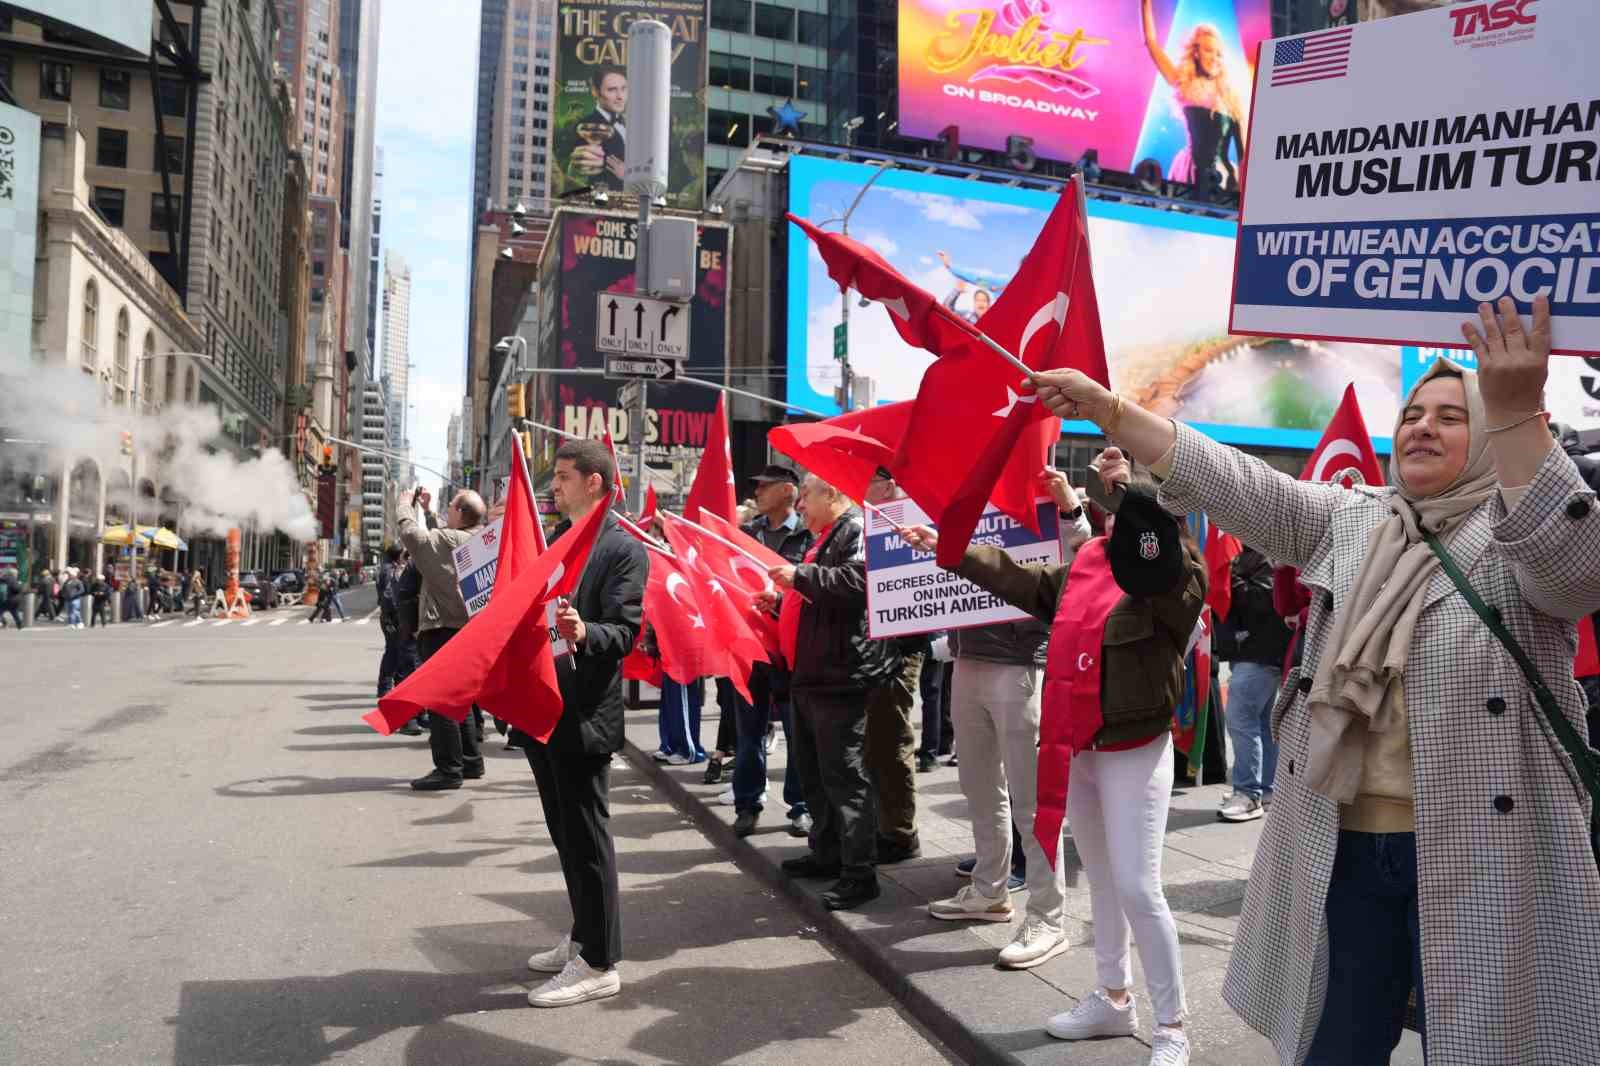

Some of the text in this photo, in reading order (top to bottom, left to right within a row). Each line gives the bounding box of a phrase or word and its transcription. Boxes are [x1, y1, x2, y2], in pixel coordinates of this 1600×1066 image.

[560, 9, 703, 42] THE GAT
[926, 8, 1111, 74] Juliet
[943, 84, 1098, 121] ON BROADWAY
[1275, 120, 1428, 160] MAMDANI
[1295, 141, 1600, 198] MUSLIM TUR
[596, 221, 627, 239] COME
[1256, 230, 1329, 256] WITH
[1330, 227, 1428, 256] MEAN
[574, 235, 636, 260] WORLD
[700, 250, 721, 270] BE
[1287, 258, 1350, 297] OF
[601, 337, 622, 347] ONLY
[629, 341, 648, 350] ONLY
[657, 344, 681, 353] ONLY
[615, 362, 665, 374] ONE WAY
[564, 405, 712, 447] HADSTOW
[877, 574, 935, 593] DECREES
[914, 589, 933, 602] ON
[876, 600, 945, 624] TURKISH
